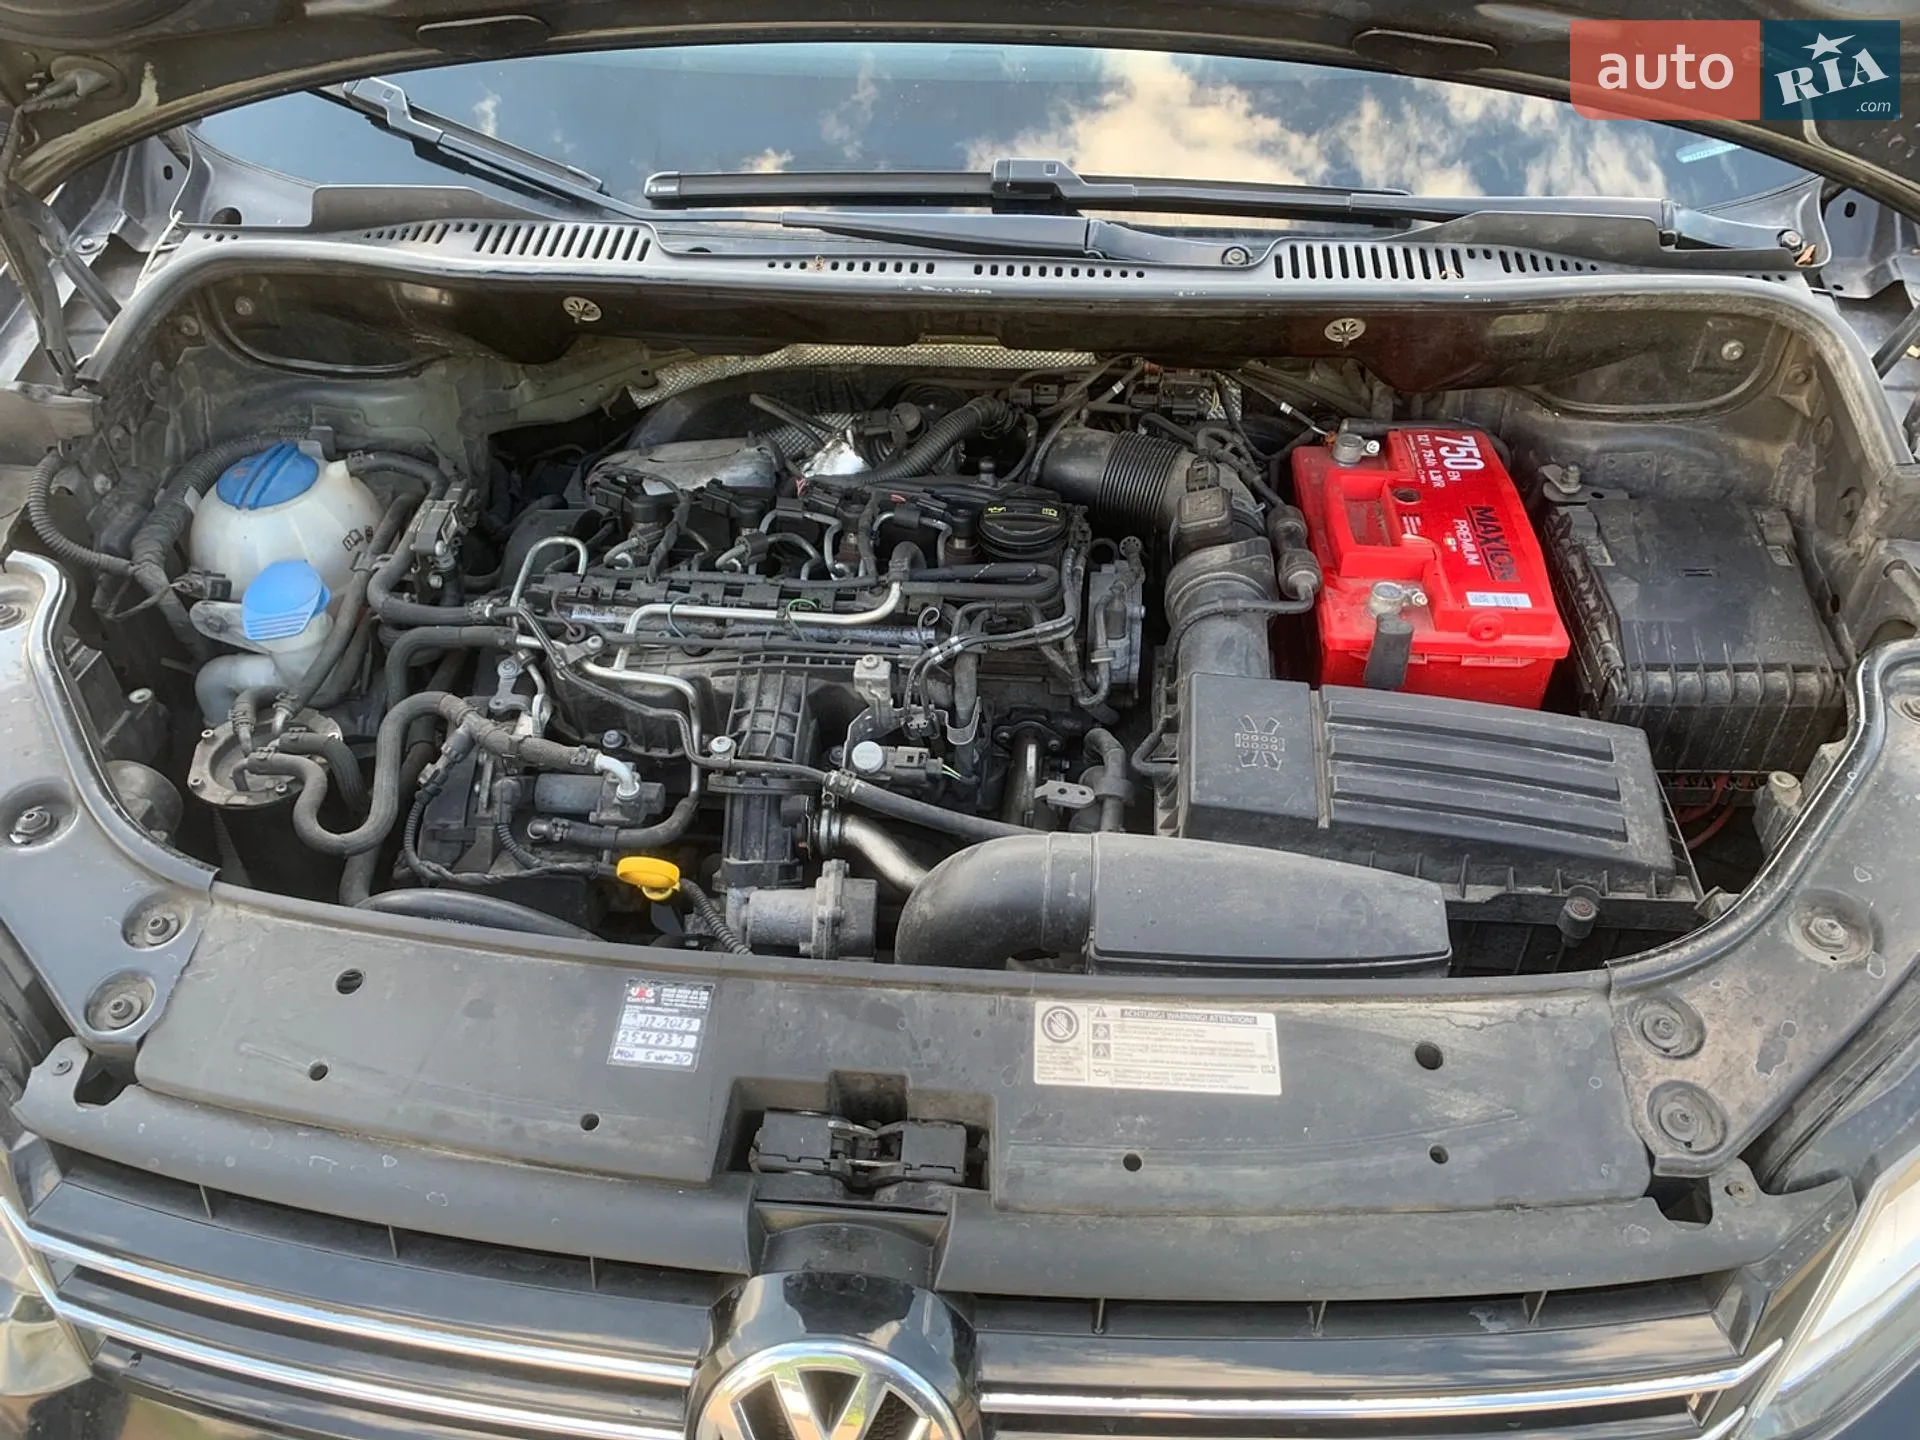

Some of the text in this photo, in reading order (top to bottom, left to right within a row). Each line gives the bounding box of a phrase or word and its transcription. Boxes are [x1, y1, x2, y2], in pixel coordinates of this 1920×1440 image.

[1435, 435, 1485, 471] 750
[1452, 519, 1481, 566] PREMIUM
[1470, 505, 1521, 583] MAXION
